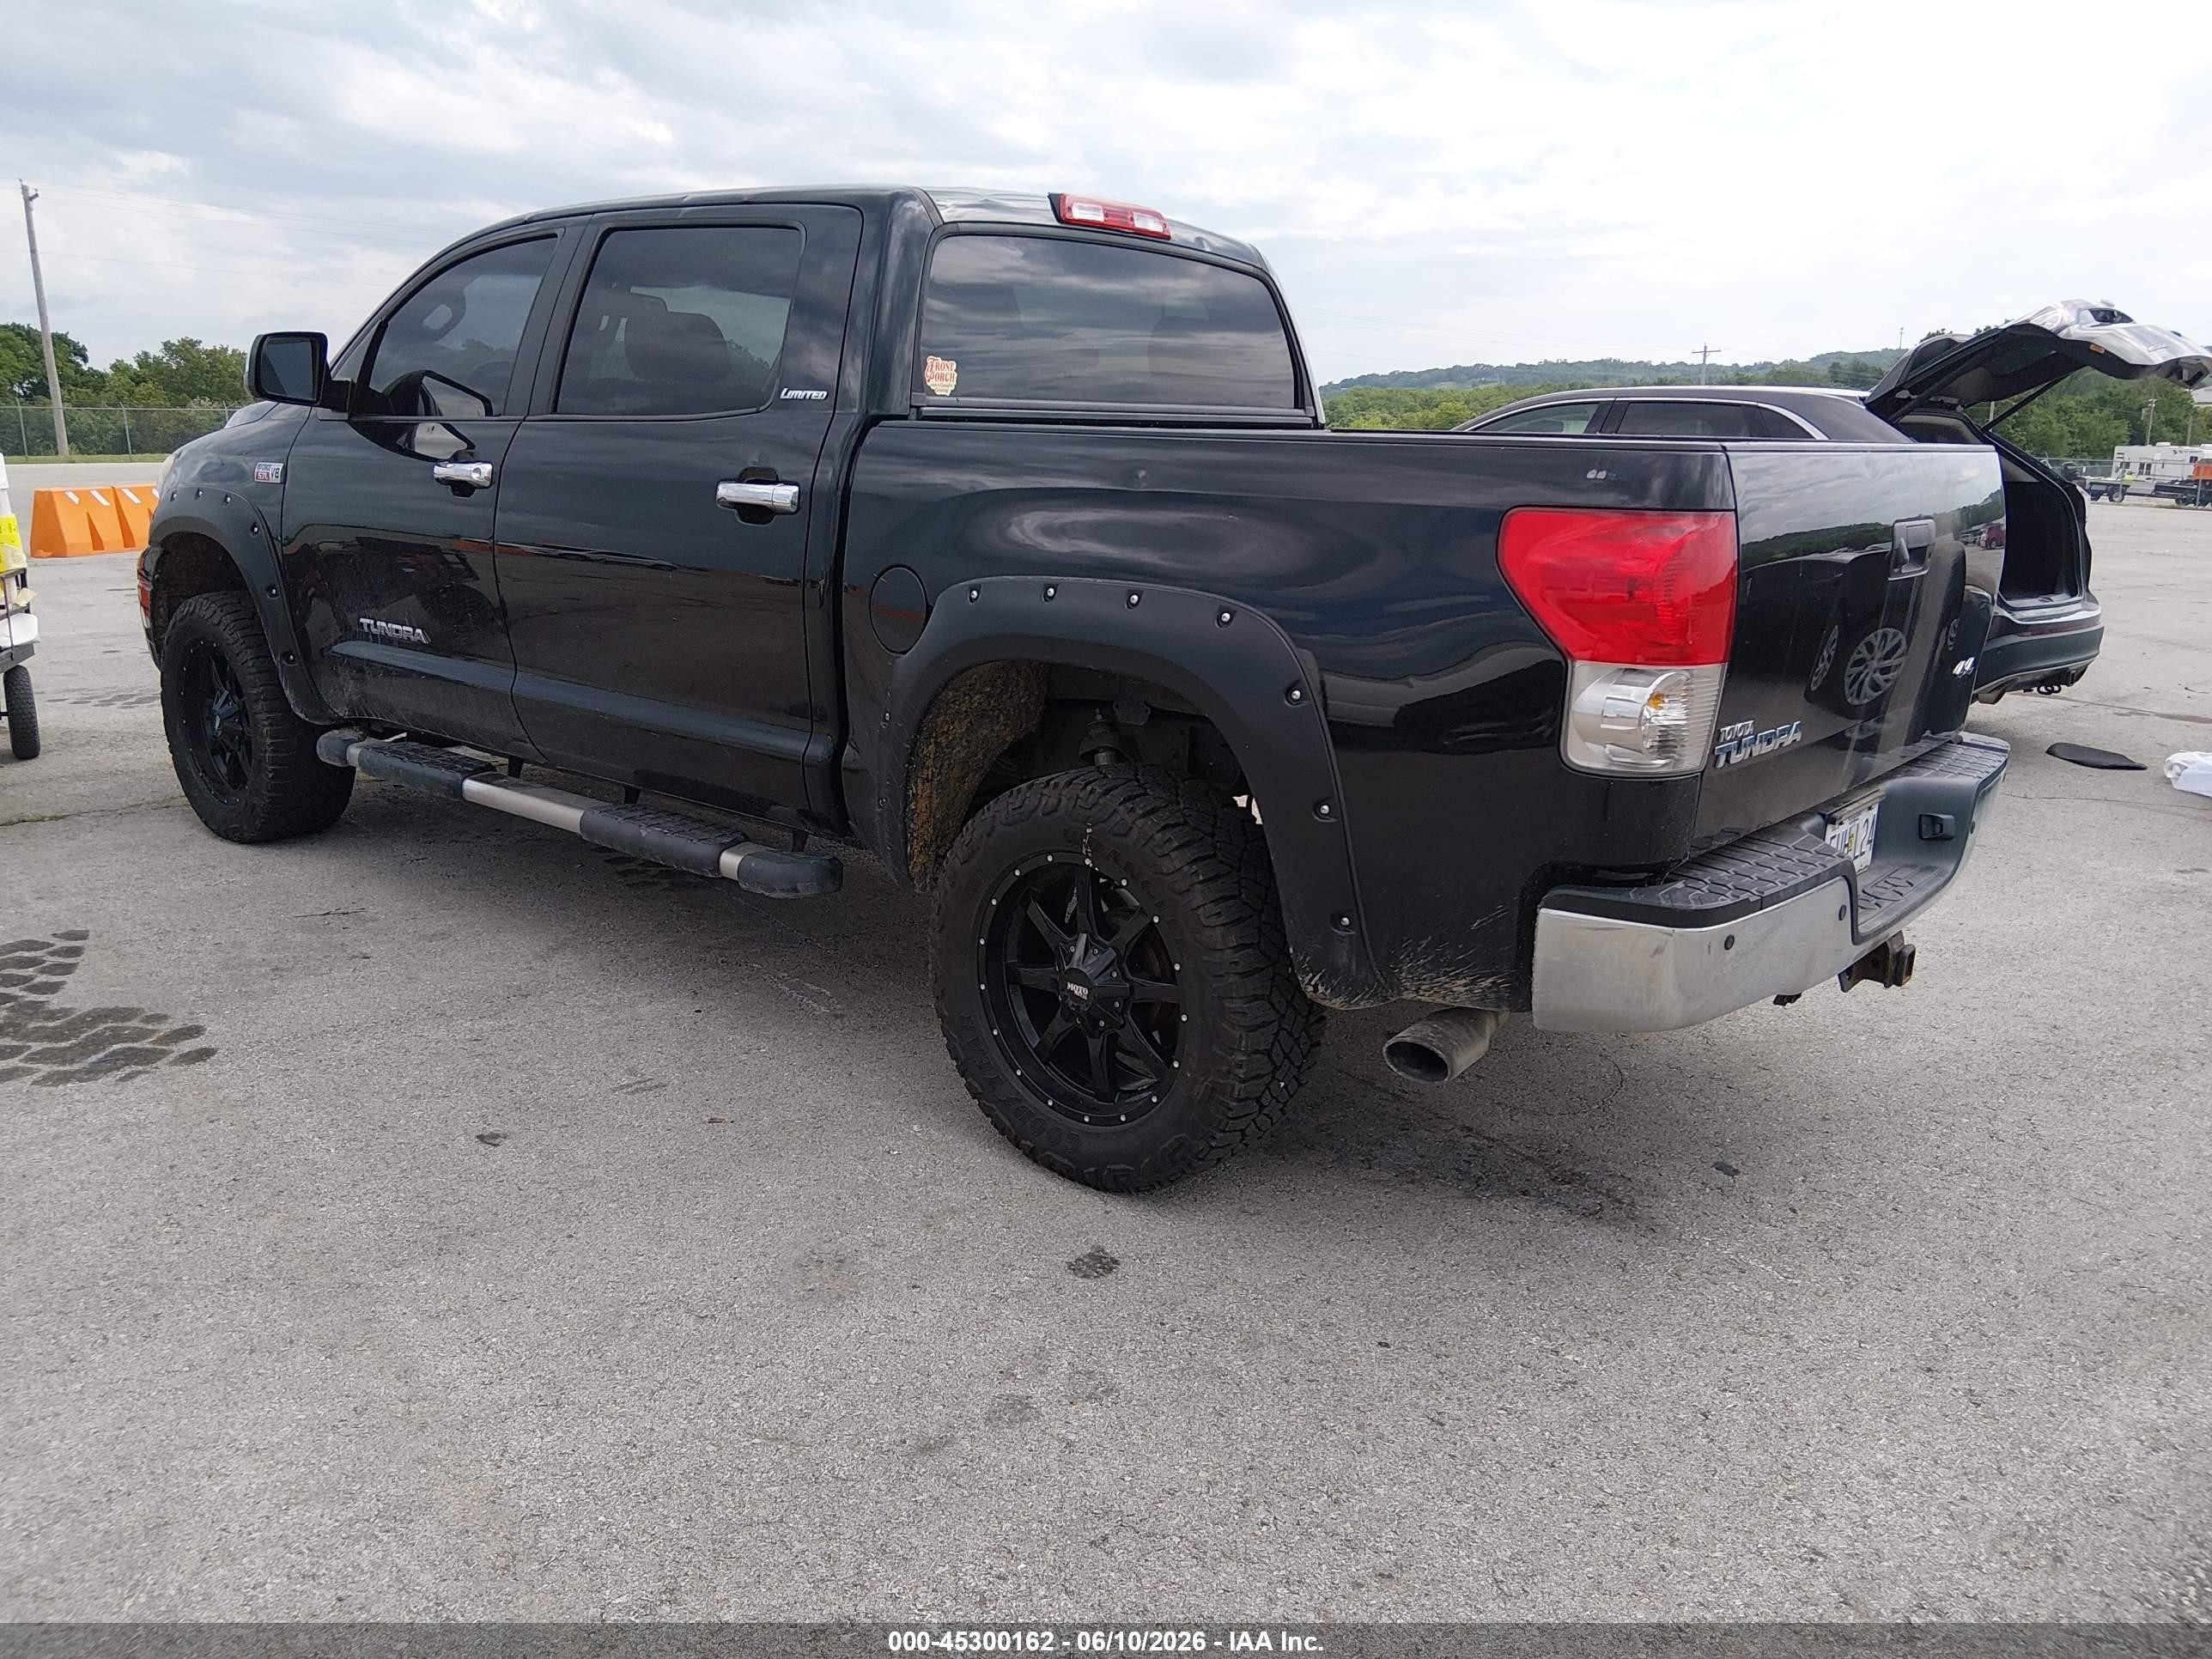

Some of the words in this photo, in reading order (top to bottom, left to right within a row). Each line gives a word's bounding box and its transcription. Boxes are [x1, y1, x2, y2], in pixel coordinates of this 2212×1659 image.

[926, 370, 956, 383] PORCH
[270, 466, 281, 479] V8
[359, 617, 430, 644] TUNDRA
[1720, 720, 1754, 743] TOYOTA
[1715, 720, 1802, 769] TUNDRA
[1066, 981, 1089, 995] MOTO
